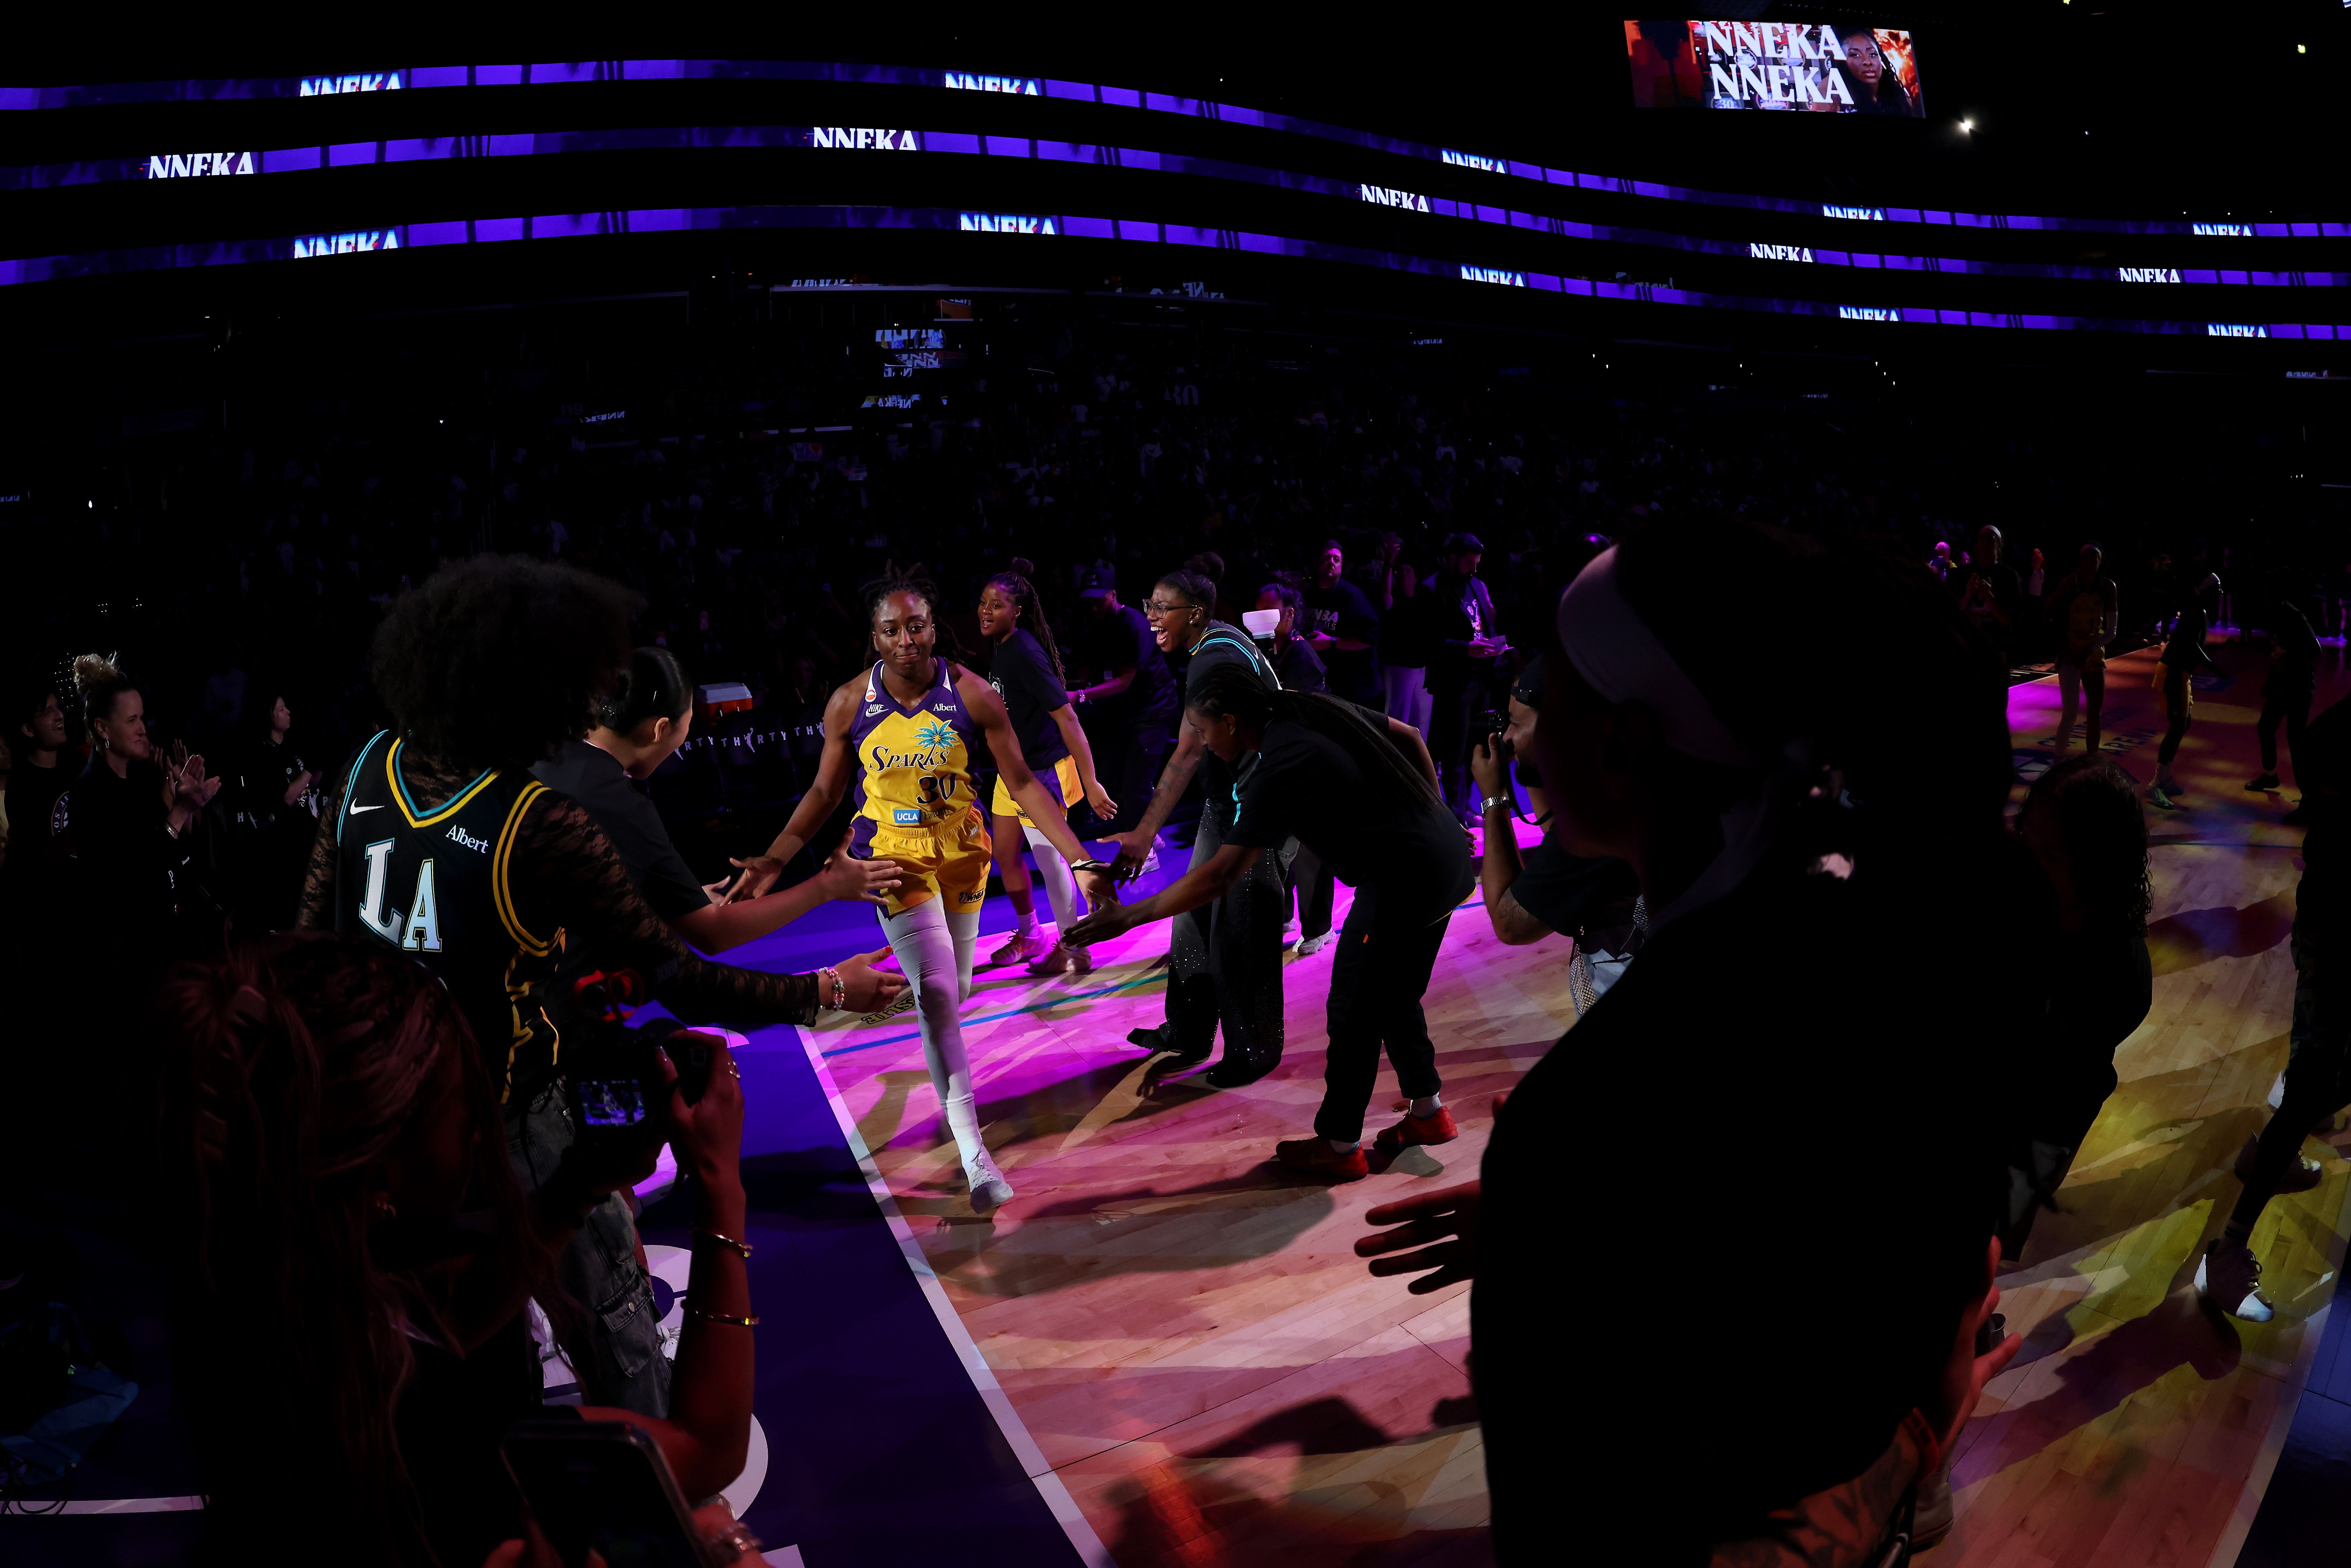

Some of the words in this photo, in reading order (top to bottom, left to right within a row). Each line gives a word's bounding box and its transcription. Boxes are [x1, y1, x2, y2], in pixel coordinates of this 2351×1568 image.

[1703, 21, 1847, 60] NNEKA
[1710, 63, 1854, 105] NNEKA
[814, 127, 917, 151] NNEKA
[149, 152, 254, 179] NNEKA
[1361, 184, 1429, 212] NNEKA
[1750, 243, 1813, 262] NNEKA
[2119, 267, 2180, 283] NNEKA
[868, 704, 884, 712] NIKE
[916, 773, 957, 805] 30
[923, 806, 950, 820] Health
[445, 824, 489, 854] Albert
[359, 837, 442, 953] LA
